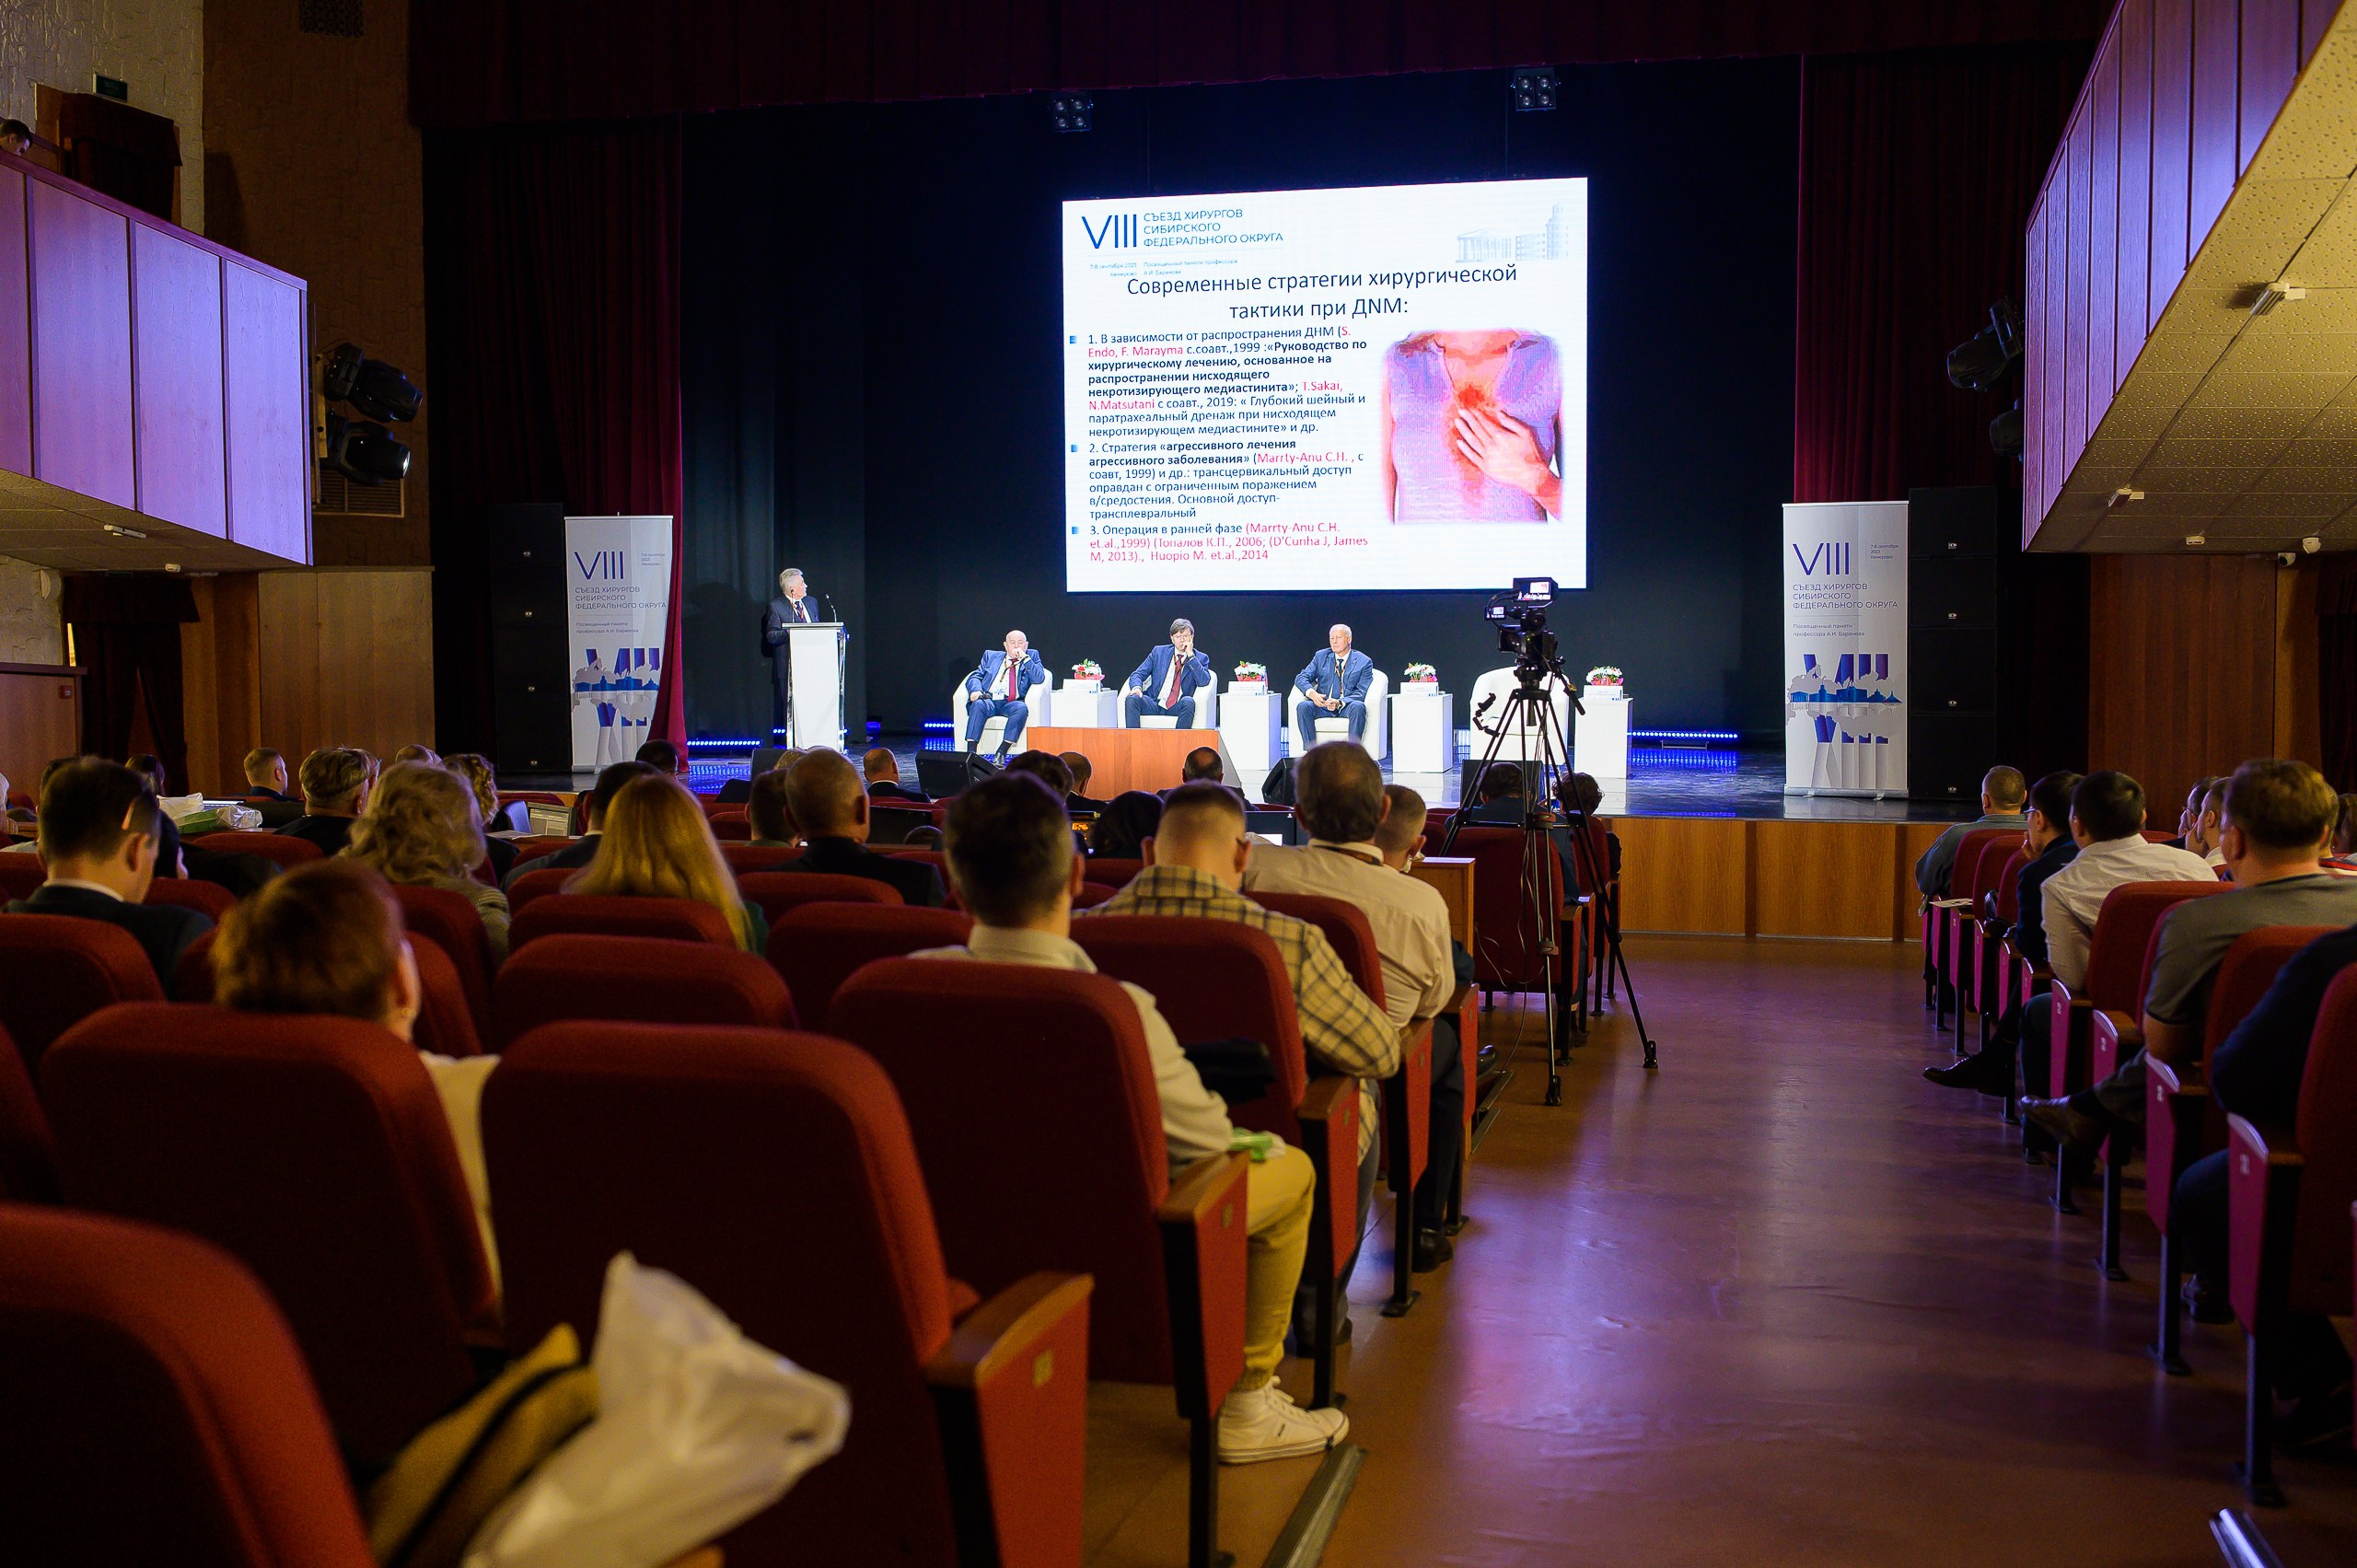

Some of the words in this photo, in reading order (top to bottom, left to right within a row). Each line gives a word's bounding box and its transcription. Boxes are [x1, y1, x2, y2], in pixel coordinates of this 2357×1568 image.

[1144, 212, 1181, 223] СЪЕЗД
[1184, 208, 1243, 220] ХИРУРГОВ
[1081, 214, 1137, 250] VIII
[1144, 223, 1221, 235] СИБИРСКОГО
[1144, 234, 1237, 248] ФЕДЕРАЛЬНОГО
[1239, 232, 1283, 243] ОКРУГА
[1127, 276, 1261, 297] Современные
[1268, 273, 1363, 294] стратегии
[1368, 263, 1517, 289] хирургической
[1229, 304, 1305, 319] тактики
[1311, 301, 1346, 320] при
[1088, 334, 1097, 344] 1.
[1101, 333, 1108, 343] В
[1110, 332, 1183, 343] зависимости
[1186, 332, 1198, 341] от
[1202, 329, 1302, 343] распространения
[1305, 327, 1334, 339] ДНМ
[1088, 347, 1119, 358] Endo,
[1121, 347, 1129, 356] F.
[1132, 346, 1184, 359] Marayma
[1353, 341, 1367, 349] по
[1088, 360, 1182, 372] хирургическому
[1185, 357, 1240, 367] лечению,
[1243, 355, 1315, 366] основанное
[1318, 355, 1332, 364] на
[1088, 373, 1190, 386] распространении
[1192, 371, 1270, 382] нисходящего
[1088, 387, 1201, 399] некротизирующего
[1203, 383, 1298, 395] медиастинита»;
[1089, 399, 1155, 411] N.Matsutani
[1167, 400, 1203, 410] соавт.,
[1206, 397, 1237, 408] 2019:
[1250, 394, 1304, 408] Глубокий
[1306, 393, 1355, 405] шейный
[1358, 395, 1365, 403] и
[1088, 411, 1188, 424] паратрахеальный
[1190, 411, 1236, 423] дренаж
[1238, 411, 1260, 421] при
[1263, 409, 1336, 420] нисходящем
[1089, 426, 1195, 438] некротизирующем
[1198, 424, 1287, 436] медиастините»
[1300, 424, 1318, 434] др.
[1089, 444, 1098, 453] 2.
[1101, 443, 1156, 454] Стратегия
[1160, 441, 1244, 453] «агрессивного
[1247, 440, 1296, 449] лечения
[1089, 457, 1165, 469] агрессивного
[1167, 455, 1249, 465] заболевания»
[1089, 470, 1122, 481] соавт,
[1125, 469, 1155, 480] 1999)
[1193, 465, 1309, 479] трансцервикальный
[1312, 466, 1352, 477] доступ
[1089, 483, 1143, 494] оправдан
[1155, 482, 1239, 493] ограниченным
[1242, 481, 1317, 492] поражением
[1089, 494, 1174, 507] в/средостения.
[1178, 494, 1234, 505] Основной
[1237, 494, 1281, 505] доступ-
[1090, 506, 1196, 521] трансплевральный
[1090, 526, 1099, 535] 3.
[1102, 525, 1158, 537] Операция
[1161, 526, 1167, 534] в
[1170, 523, 1212, 536] ранней
[1215, 523, 1243, 535] фазе
[1236, 537, 1266, 548] 2006;
[1334, 536, 1368, 546] James
[1090, 552, 1104, 563] M,
[1151, 551, 1190, 563] Huopio
[1193, 551, 1207, 561] M.
[1792, 541, 1850, 575] VIII
[574, 551, 624, 580] VIII
[1793, 601, 1864, 610] ФЕДЕРАЛЬНОГО
